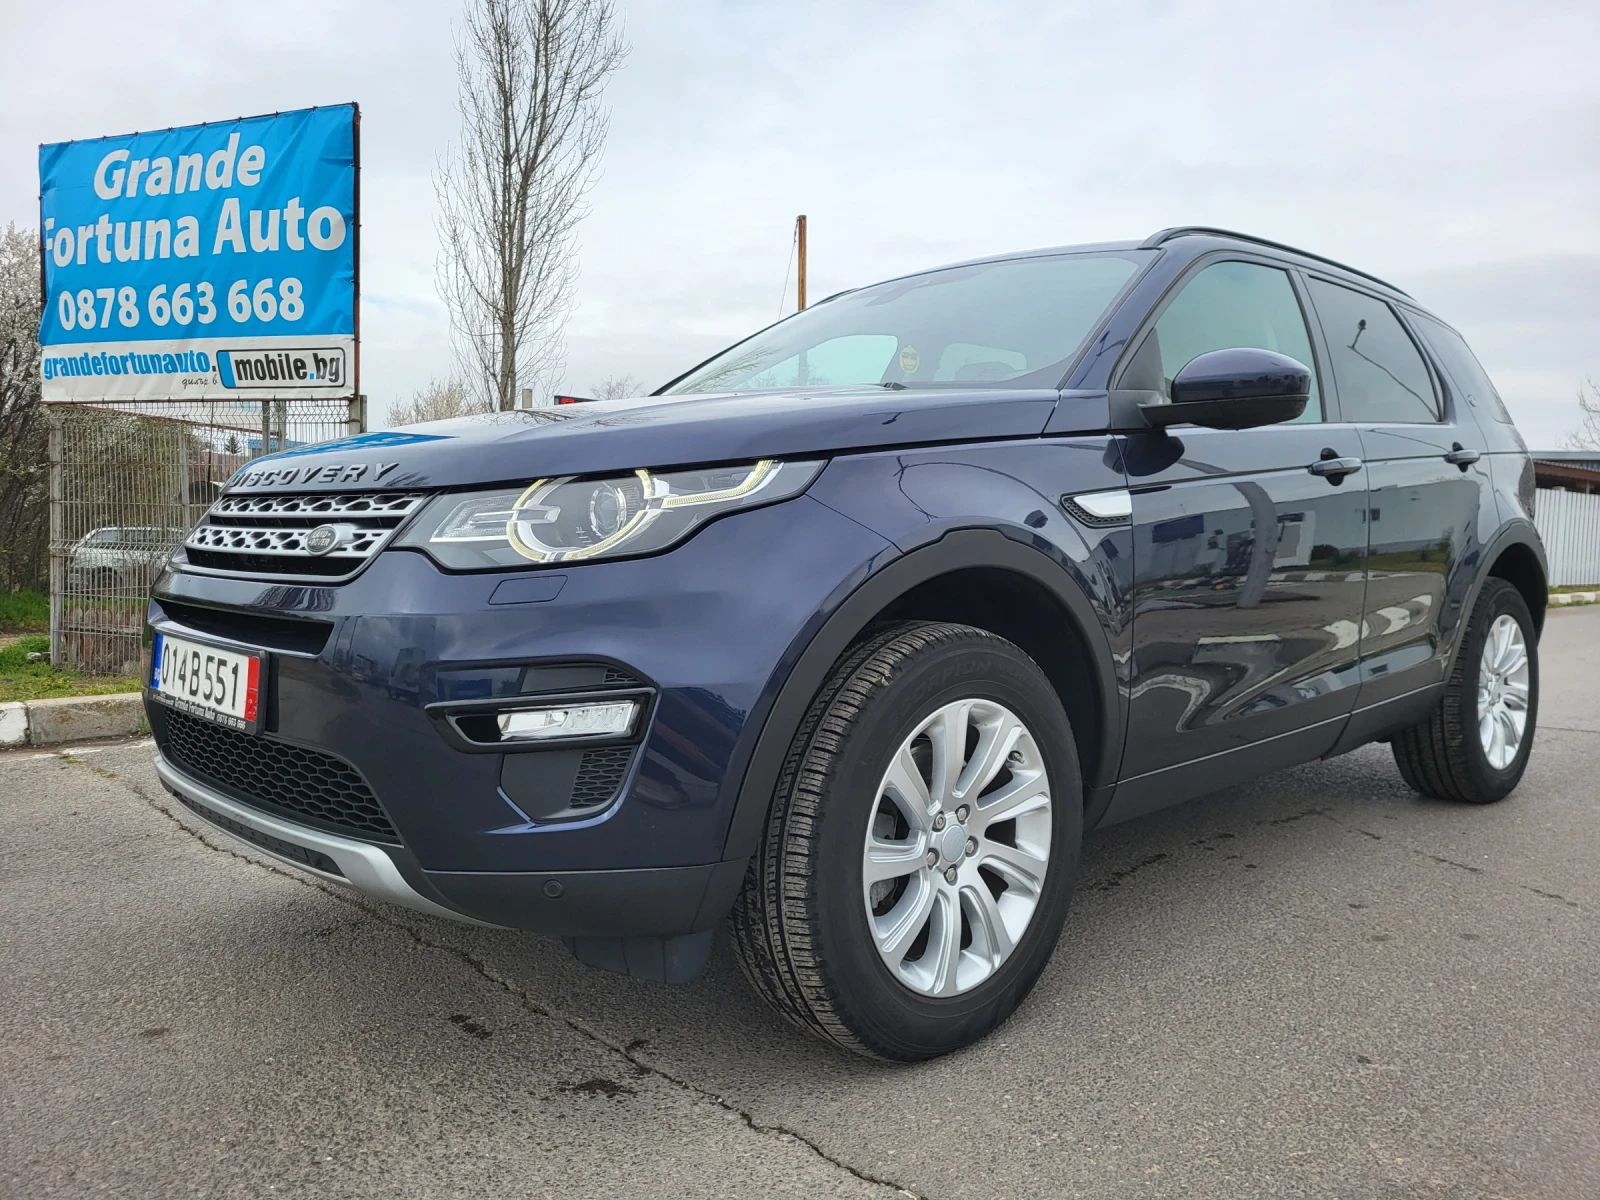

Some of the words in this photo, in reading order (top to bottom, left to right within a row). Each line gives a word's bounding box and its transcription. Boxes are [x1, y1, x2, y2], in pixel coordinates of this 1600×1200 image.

[94, 132, 265, 200] Grande
[212, 196, 347, 255] Auto
[58, 286, 140, 331] 0878
[148, 281, 217, 327] 663
[227, 277, 305, 323] 668
[234, 352, 341, 383] mobile.bg
[229, 462, 400, 488] DISCOVERY
[162, 642, 240, 711] 014B551
